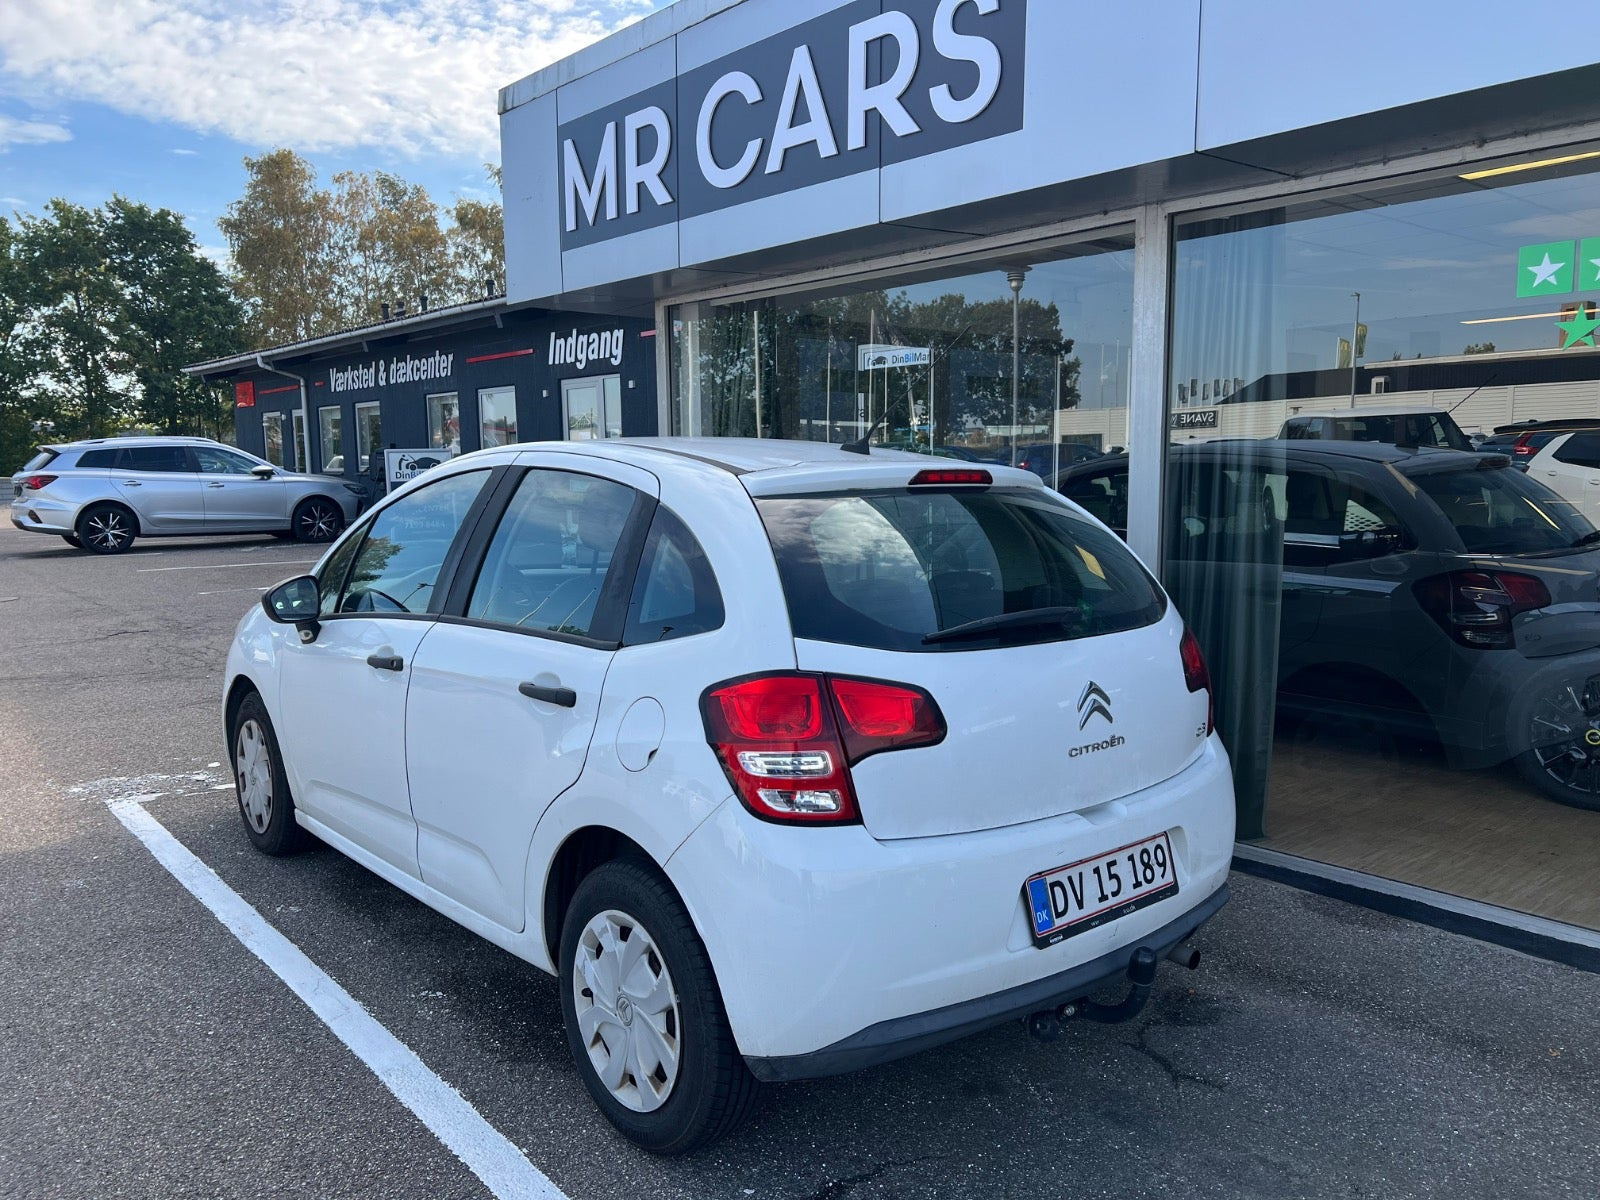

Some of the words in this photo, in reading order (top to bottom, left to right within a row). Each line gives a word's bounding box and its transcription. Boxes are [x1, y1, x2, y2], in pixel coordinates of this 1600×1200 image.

[563, 105, 674, 232] MR
[695, 0, 1002, 189] CARS
[548, 328, 624, 370] Indgang
[329, 361, 375, 393] Værksted
[378, 359, 387, 386] &
[389, 350, 454, 385] dækcenter
[1049, 871, 1084, 919] DV
[1092, 859, 1122, 904] 15
[1128, 843, 1167, 890] 189
[1036, 909, 1049, 924] DK
